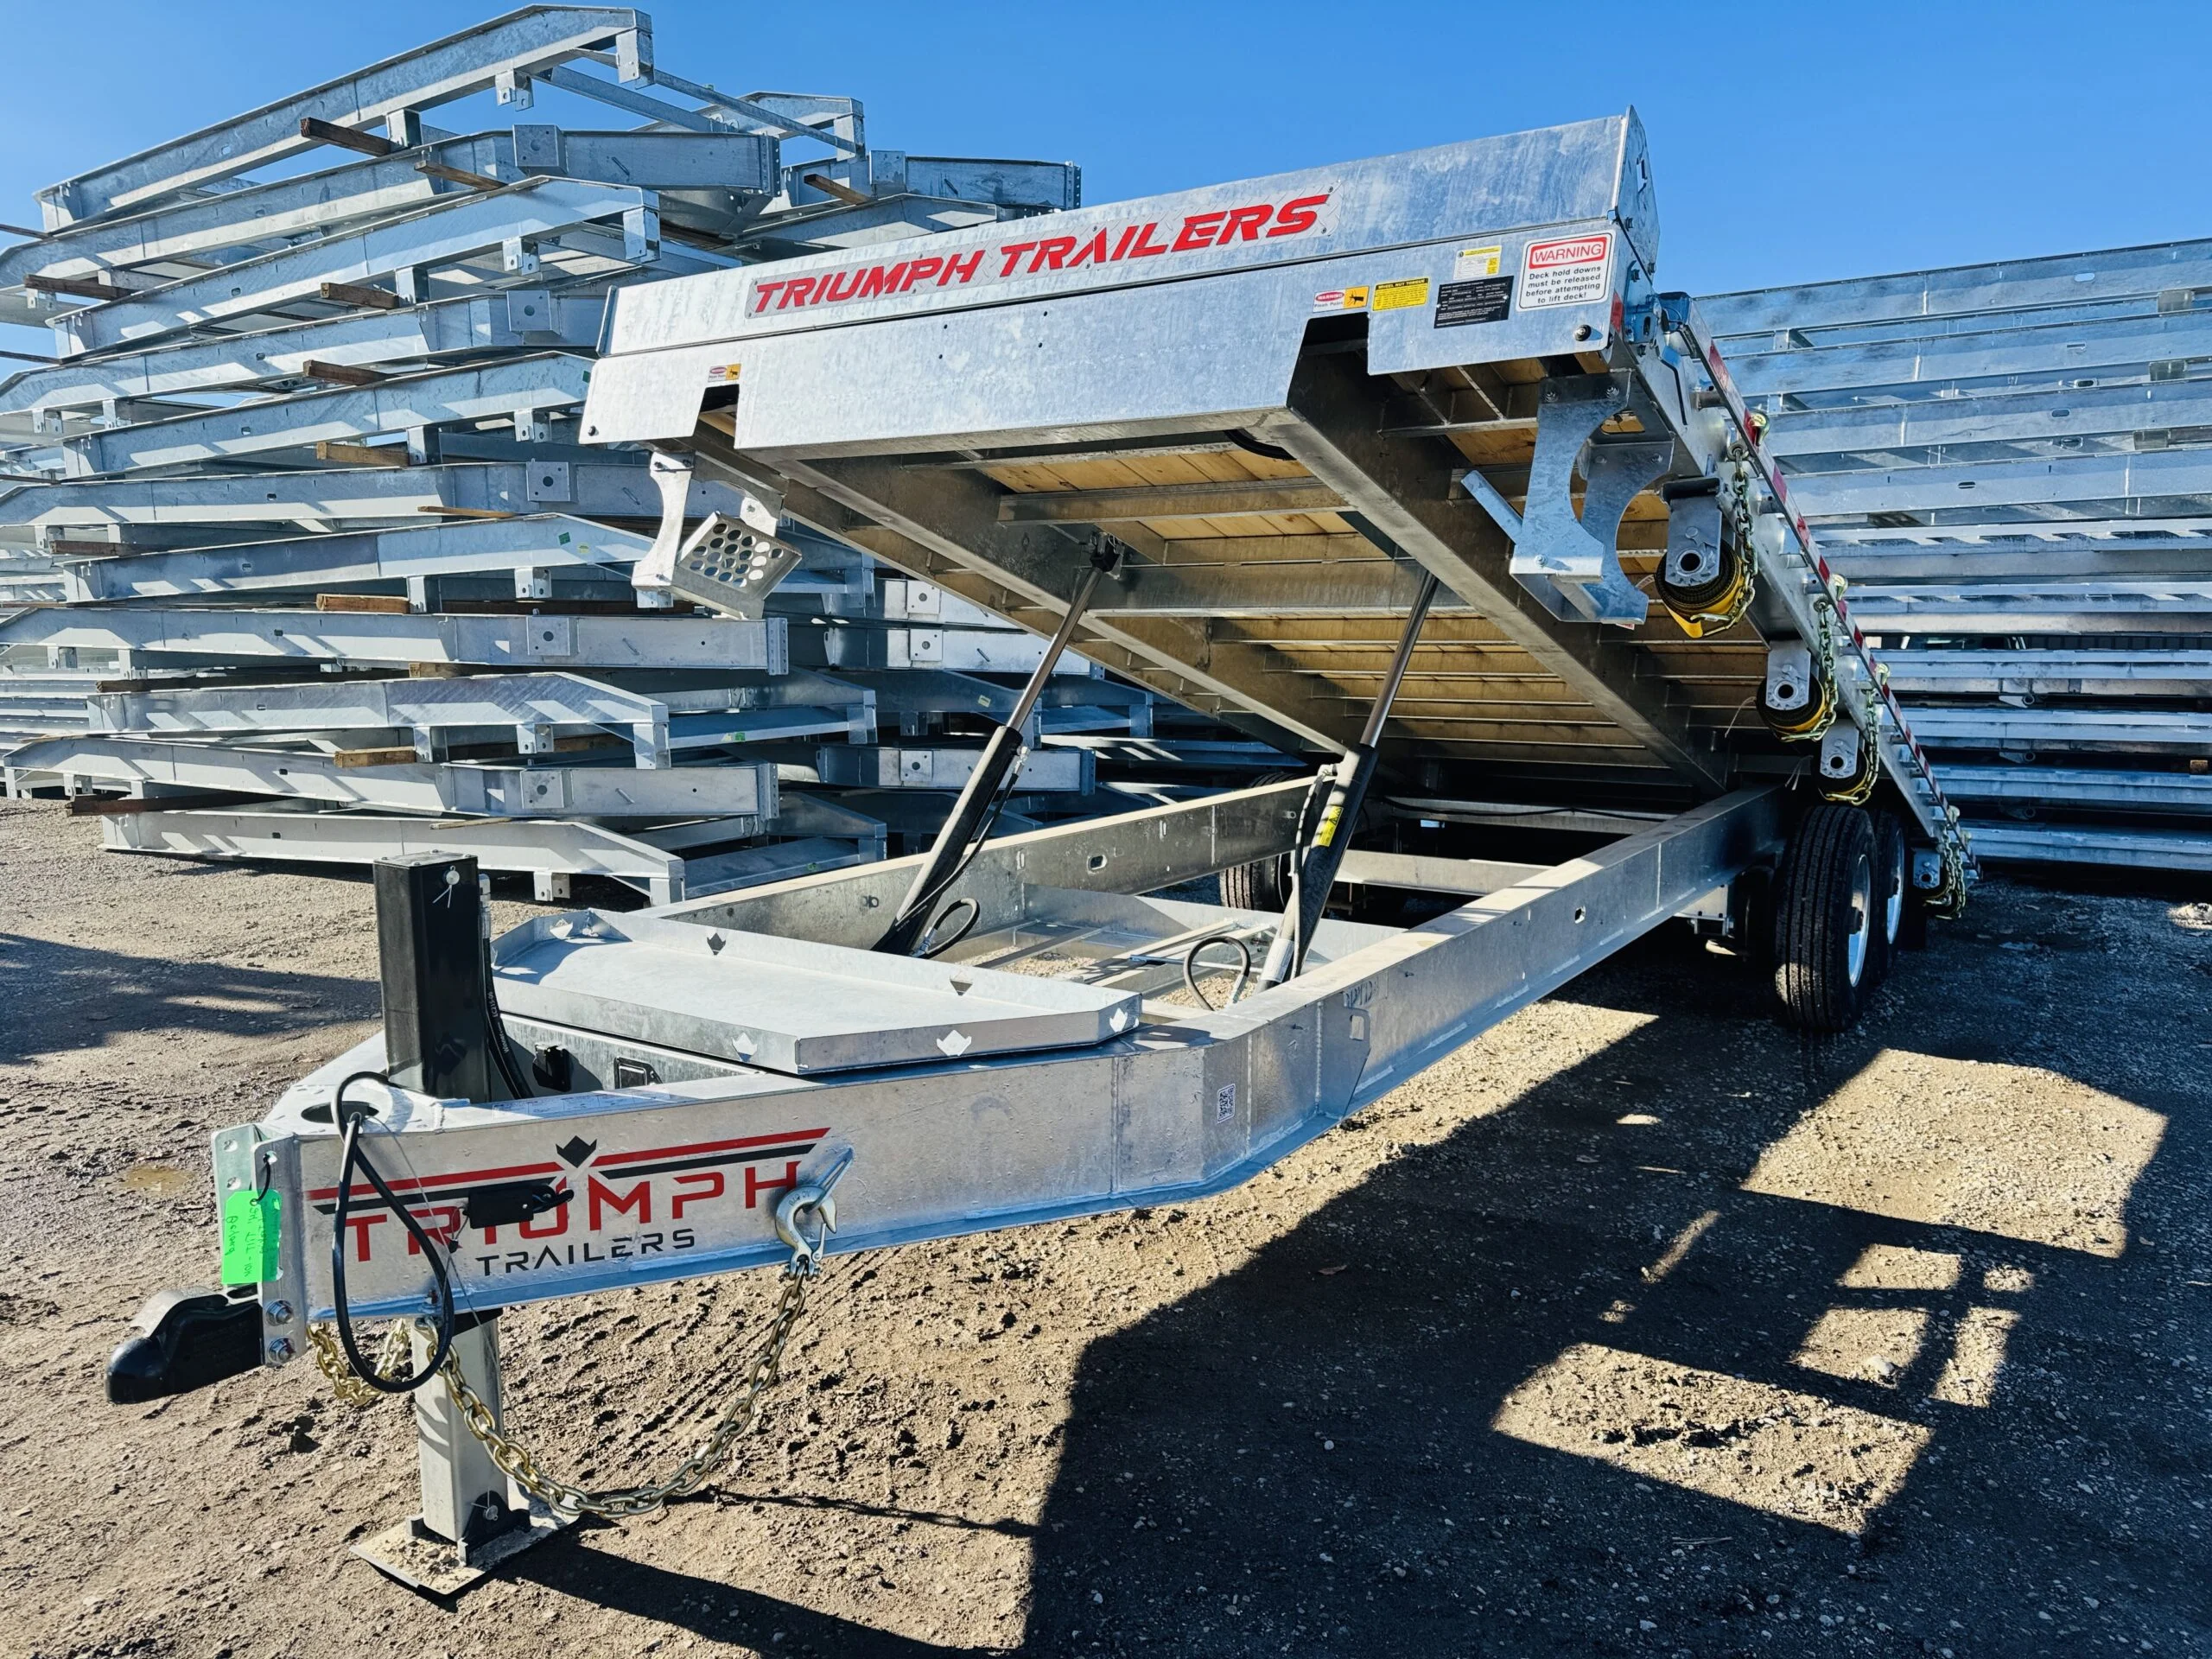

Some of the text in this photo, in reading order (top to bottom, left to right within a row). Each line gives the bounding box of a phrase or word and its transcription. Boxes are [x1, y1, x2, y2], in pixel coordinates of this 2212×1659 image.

[755, 194, 1331, 313] TRIUMPH TRAILERS
[1535, 244, 1602, 263] WARNING
[1573, 266, 1601, 275] downs
[1565, 274, 1601, 283] released
[1526, 283, 1601, 297] before attempting
[1564, 292, 1586, 301] deck!
[475, 1229, 695, 1276] TRAILERS
